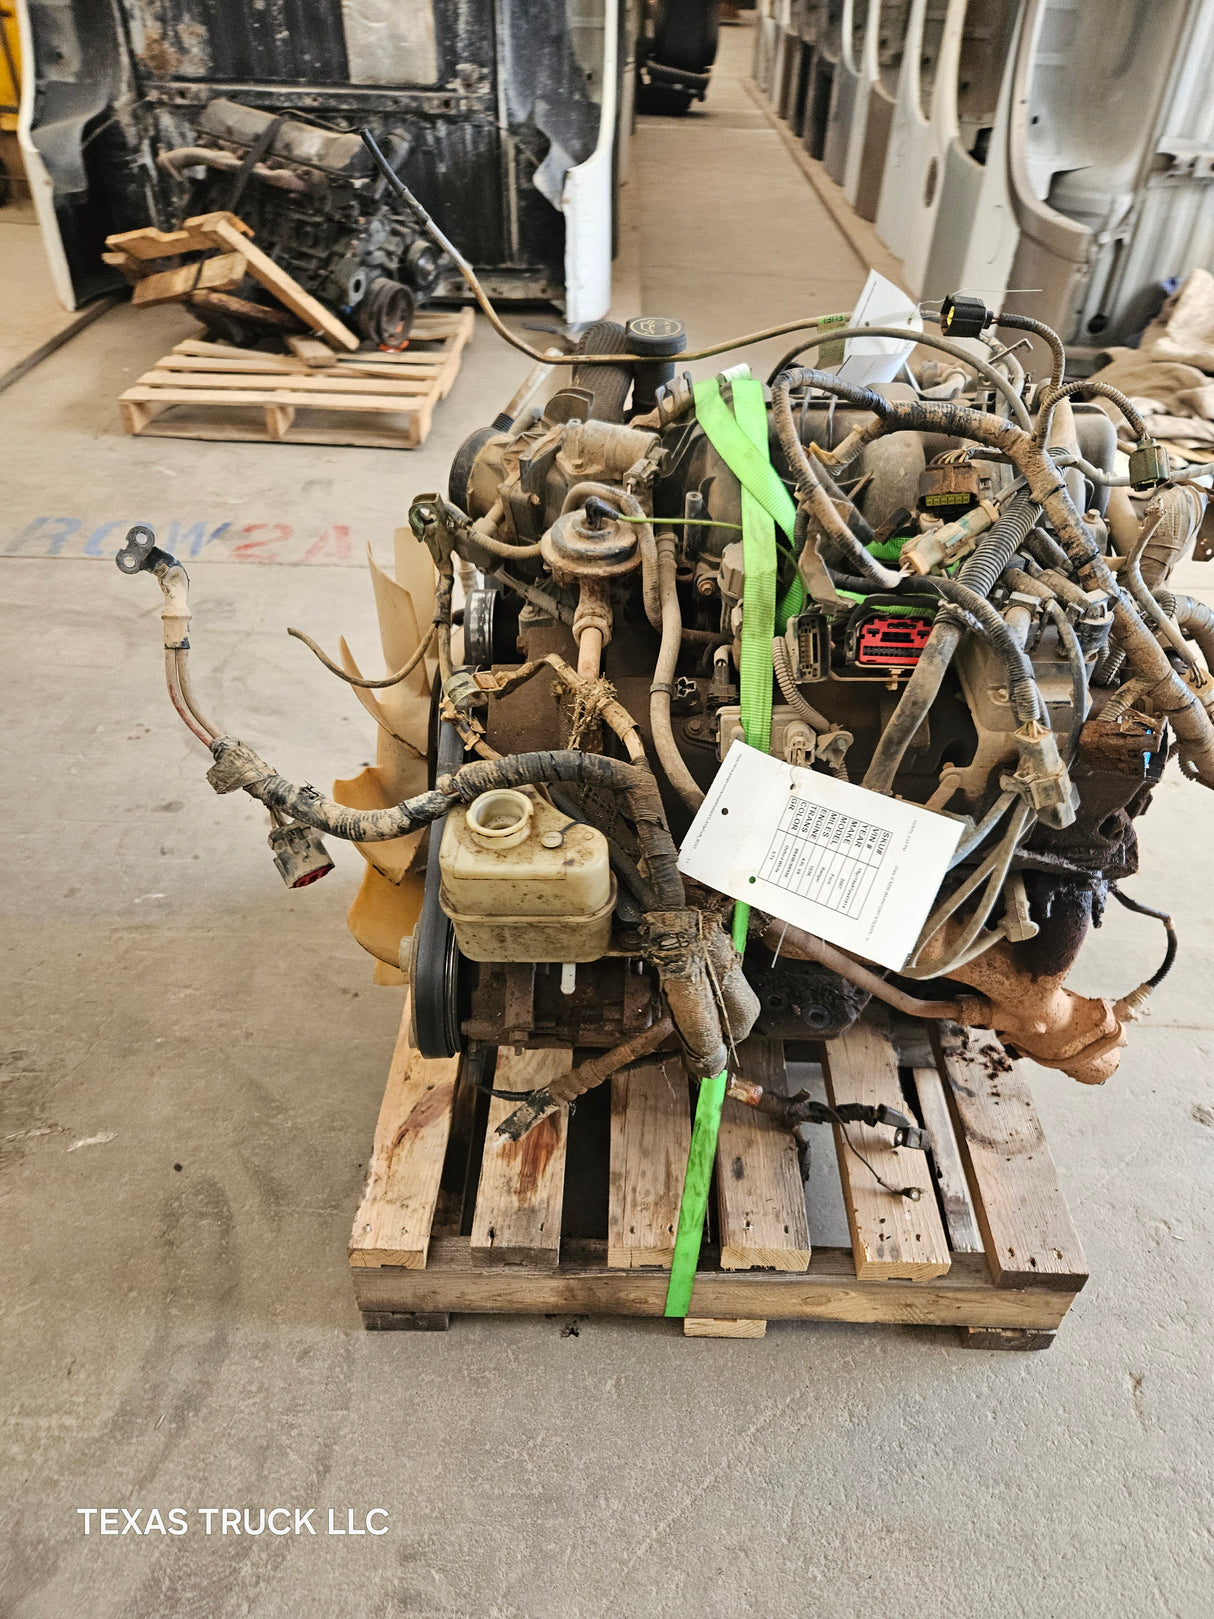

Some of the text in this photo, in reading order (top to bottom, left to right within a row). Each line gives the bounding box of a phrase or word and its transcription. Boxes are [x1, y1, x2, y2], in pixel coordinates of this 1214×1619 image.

[788, 798, 797, 811] GR
[791, 801, 807, 831] COLOR
[801, 805, 817, 833] TRANS
[810, 809, 827, 840] ENGINE
[822, 813, 837, 838] MILES
[831, 816, 848, 846] MODEL
[843, 820, 858, 845] MAKE
[854, 824, 868, 848] YEAR
[869, 828, 879, 842] VIN
[875, 832, 890, 855] SKU#
